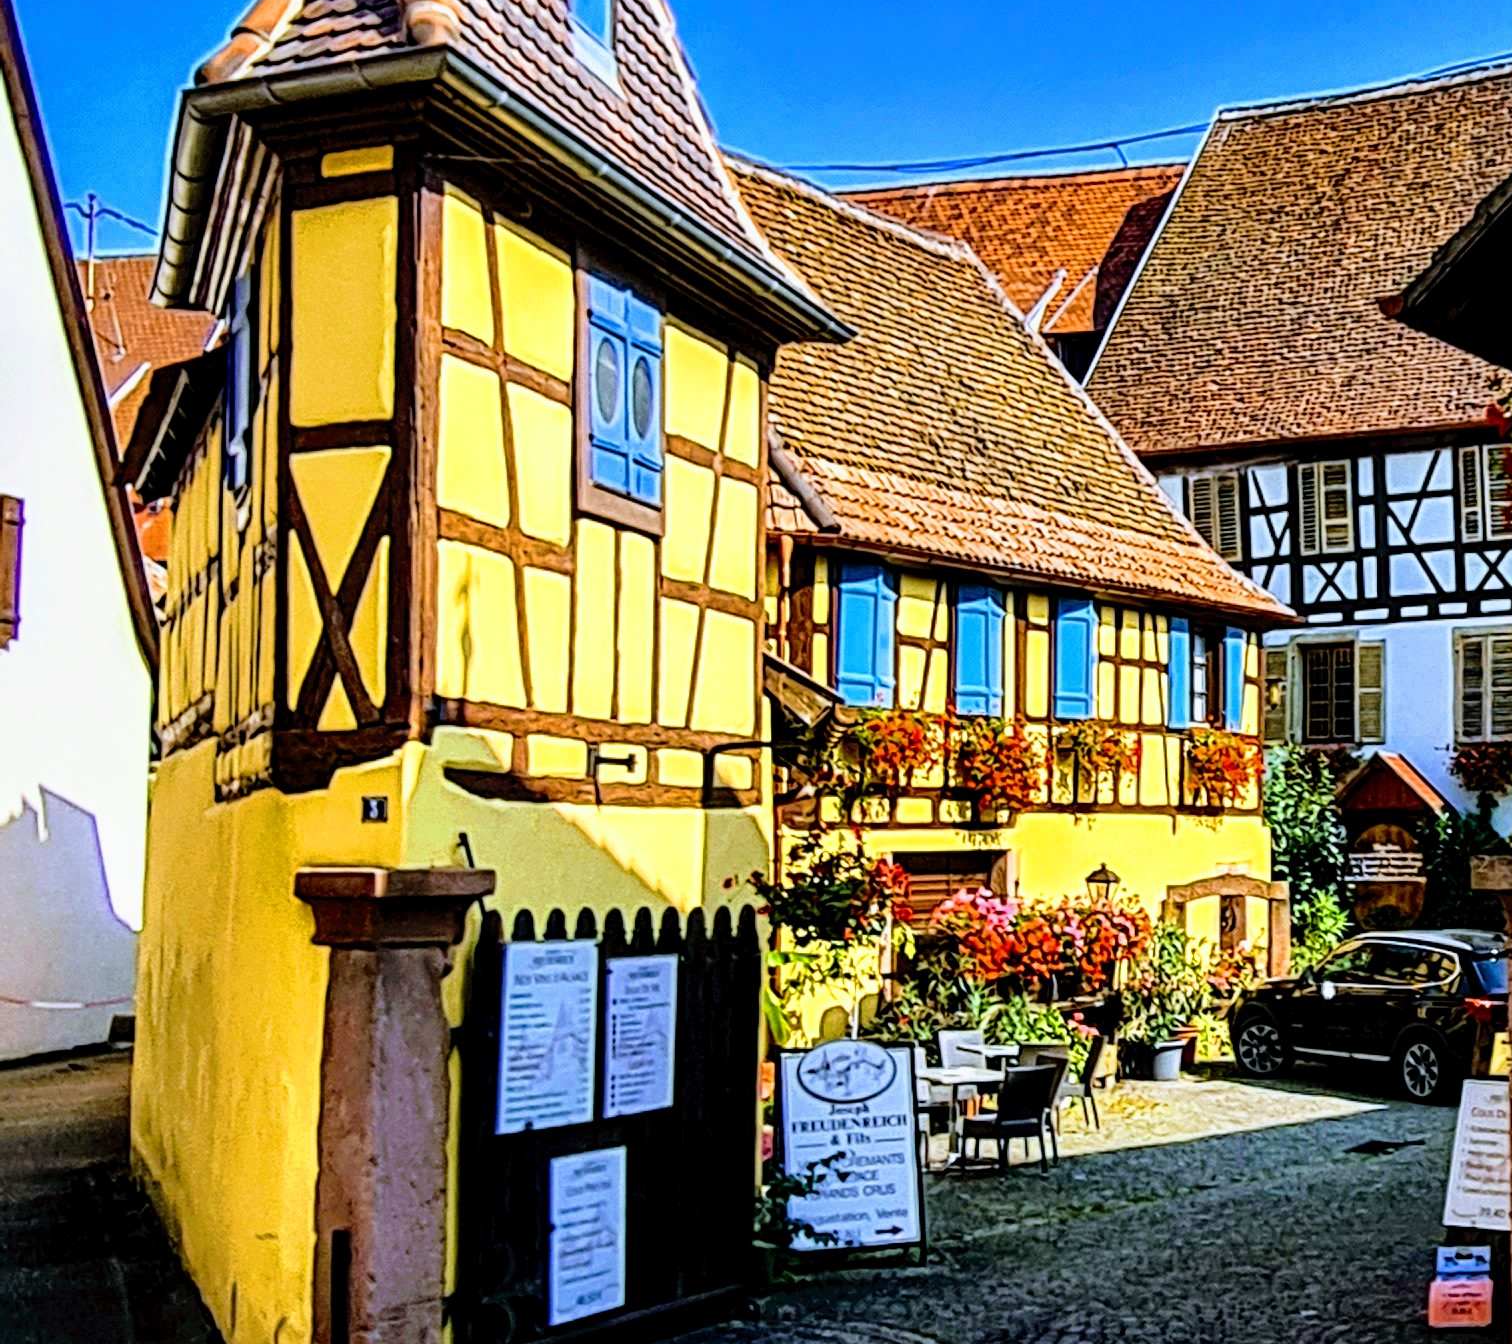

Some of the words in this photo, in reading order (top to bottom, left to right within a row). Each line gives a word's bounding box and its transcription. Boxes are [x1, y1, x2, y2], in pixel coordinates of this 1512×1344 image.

[829, 1103, 870, 1116] Joseph
[791, 1114, 907, 1134] FREUDENREICH
[830, 1134, 840, 1146] &
[846, 1132, 872, 1145] Fils
